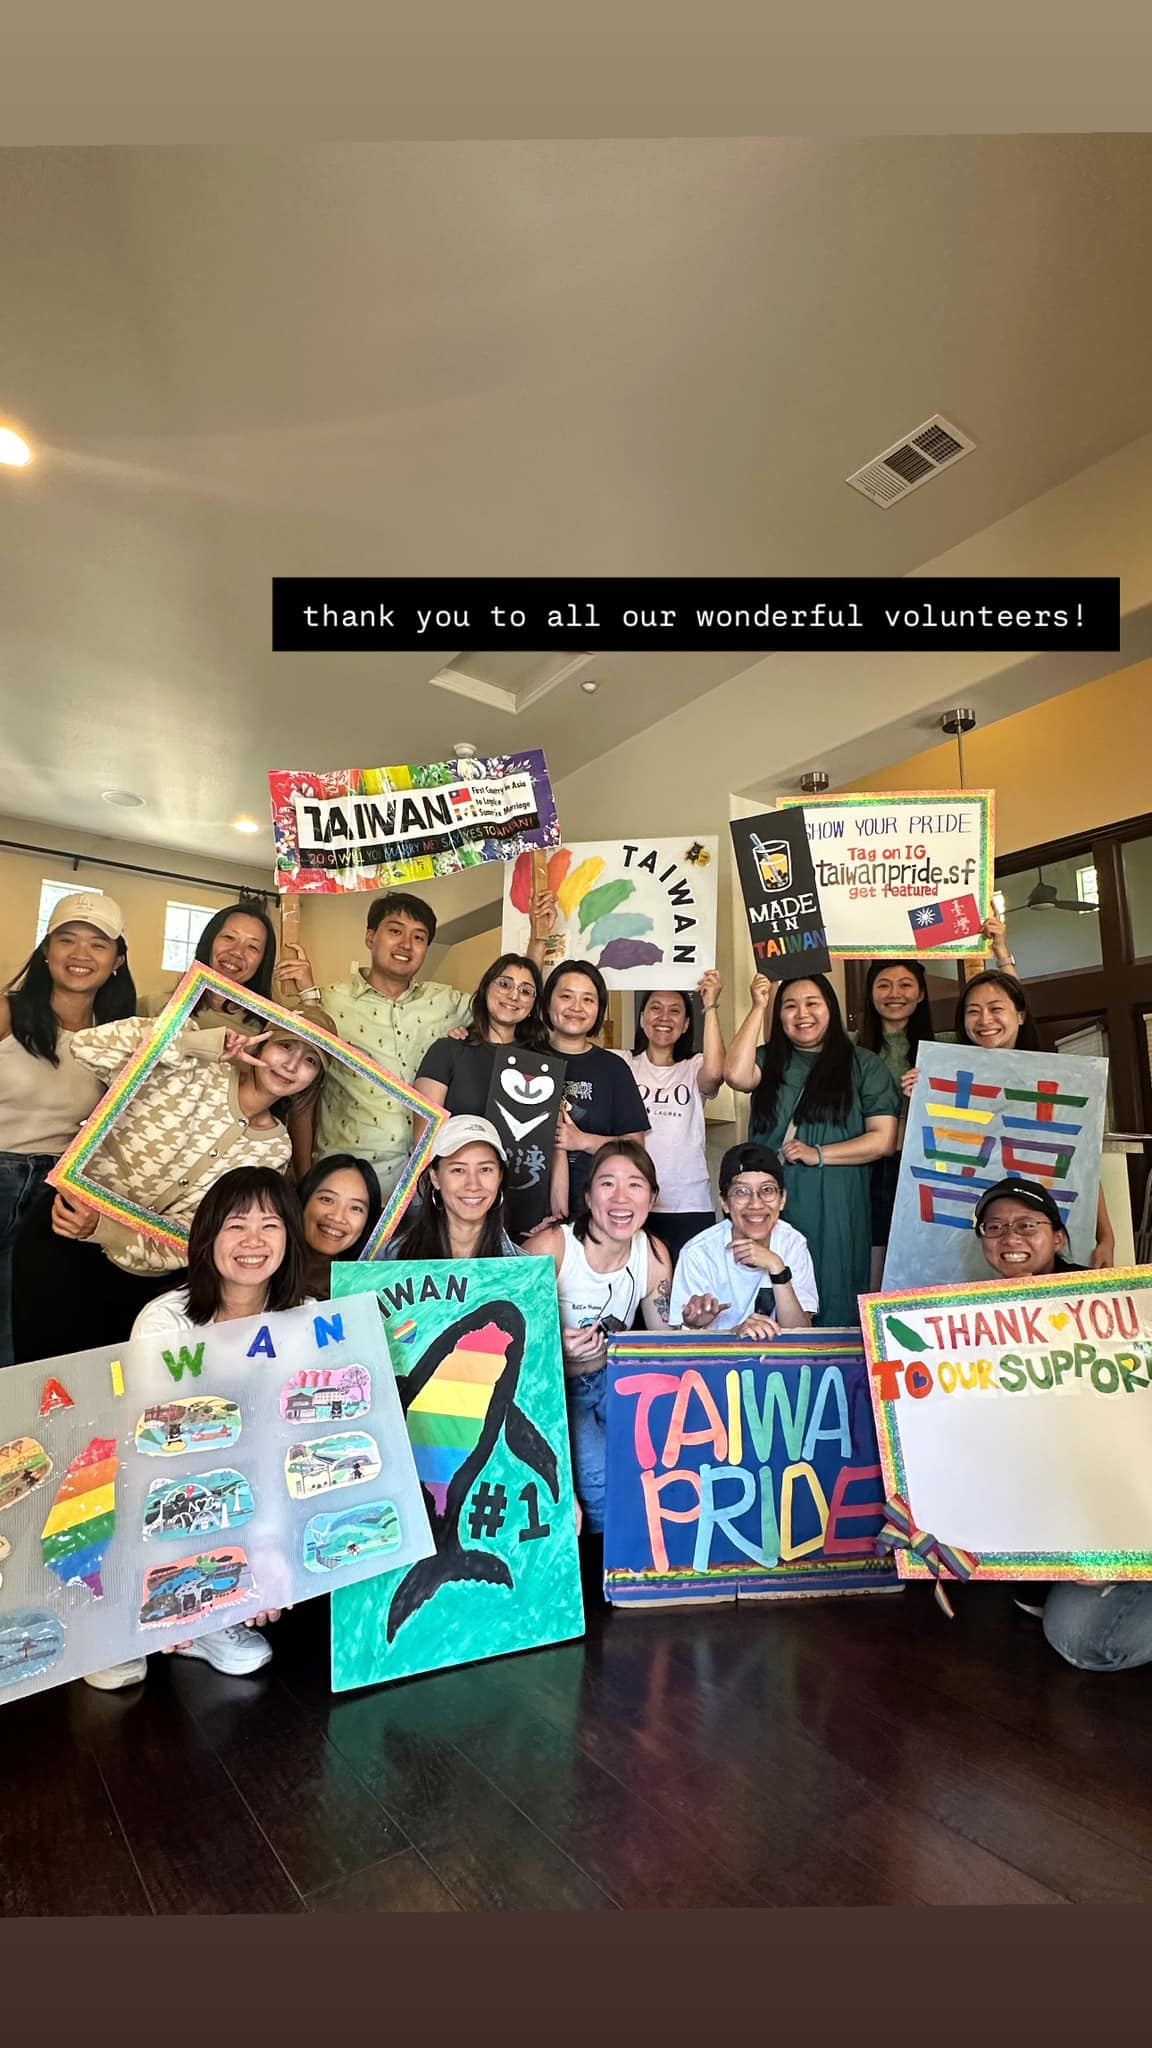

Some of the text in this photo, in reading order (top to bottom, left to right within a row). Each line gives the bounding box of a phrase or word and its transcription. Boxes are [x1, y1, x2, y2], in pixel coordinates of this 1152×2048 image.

[304, 794, 453, 843] TAIWAN
[805, 813, 973, 841] SHOW YOUR PRIDE
[309, 852, 336, 866] 209
[462, 827, 483, 841] YES
[483, 825, 496, 837] TO
[847, 845, 927, 862] Tag on IG
[815, 858, 976, 891] taiwanpride.sf
[848, 883, 939, 899] get featured
[622, 845, 697, 964] TAIWAN
[749, 893, 817, 923] MADE
[771, 916, 800, 933] IN
[753, 929, 828, 959] TAIWAN
[637, 1084, 691, 1106] OLO
[376, 1273, 469, 1319] IWAN
[925, 1295, 1140, 1350] THANK YOU
[38, 1313, 346, 1418] AIWAN
[872, 1342, 1152, 1401] TO OUR SUPPOR
[467, 1481, 551, 1543] #1
[641, 1461, 885, 1574] PRIDE
